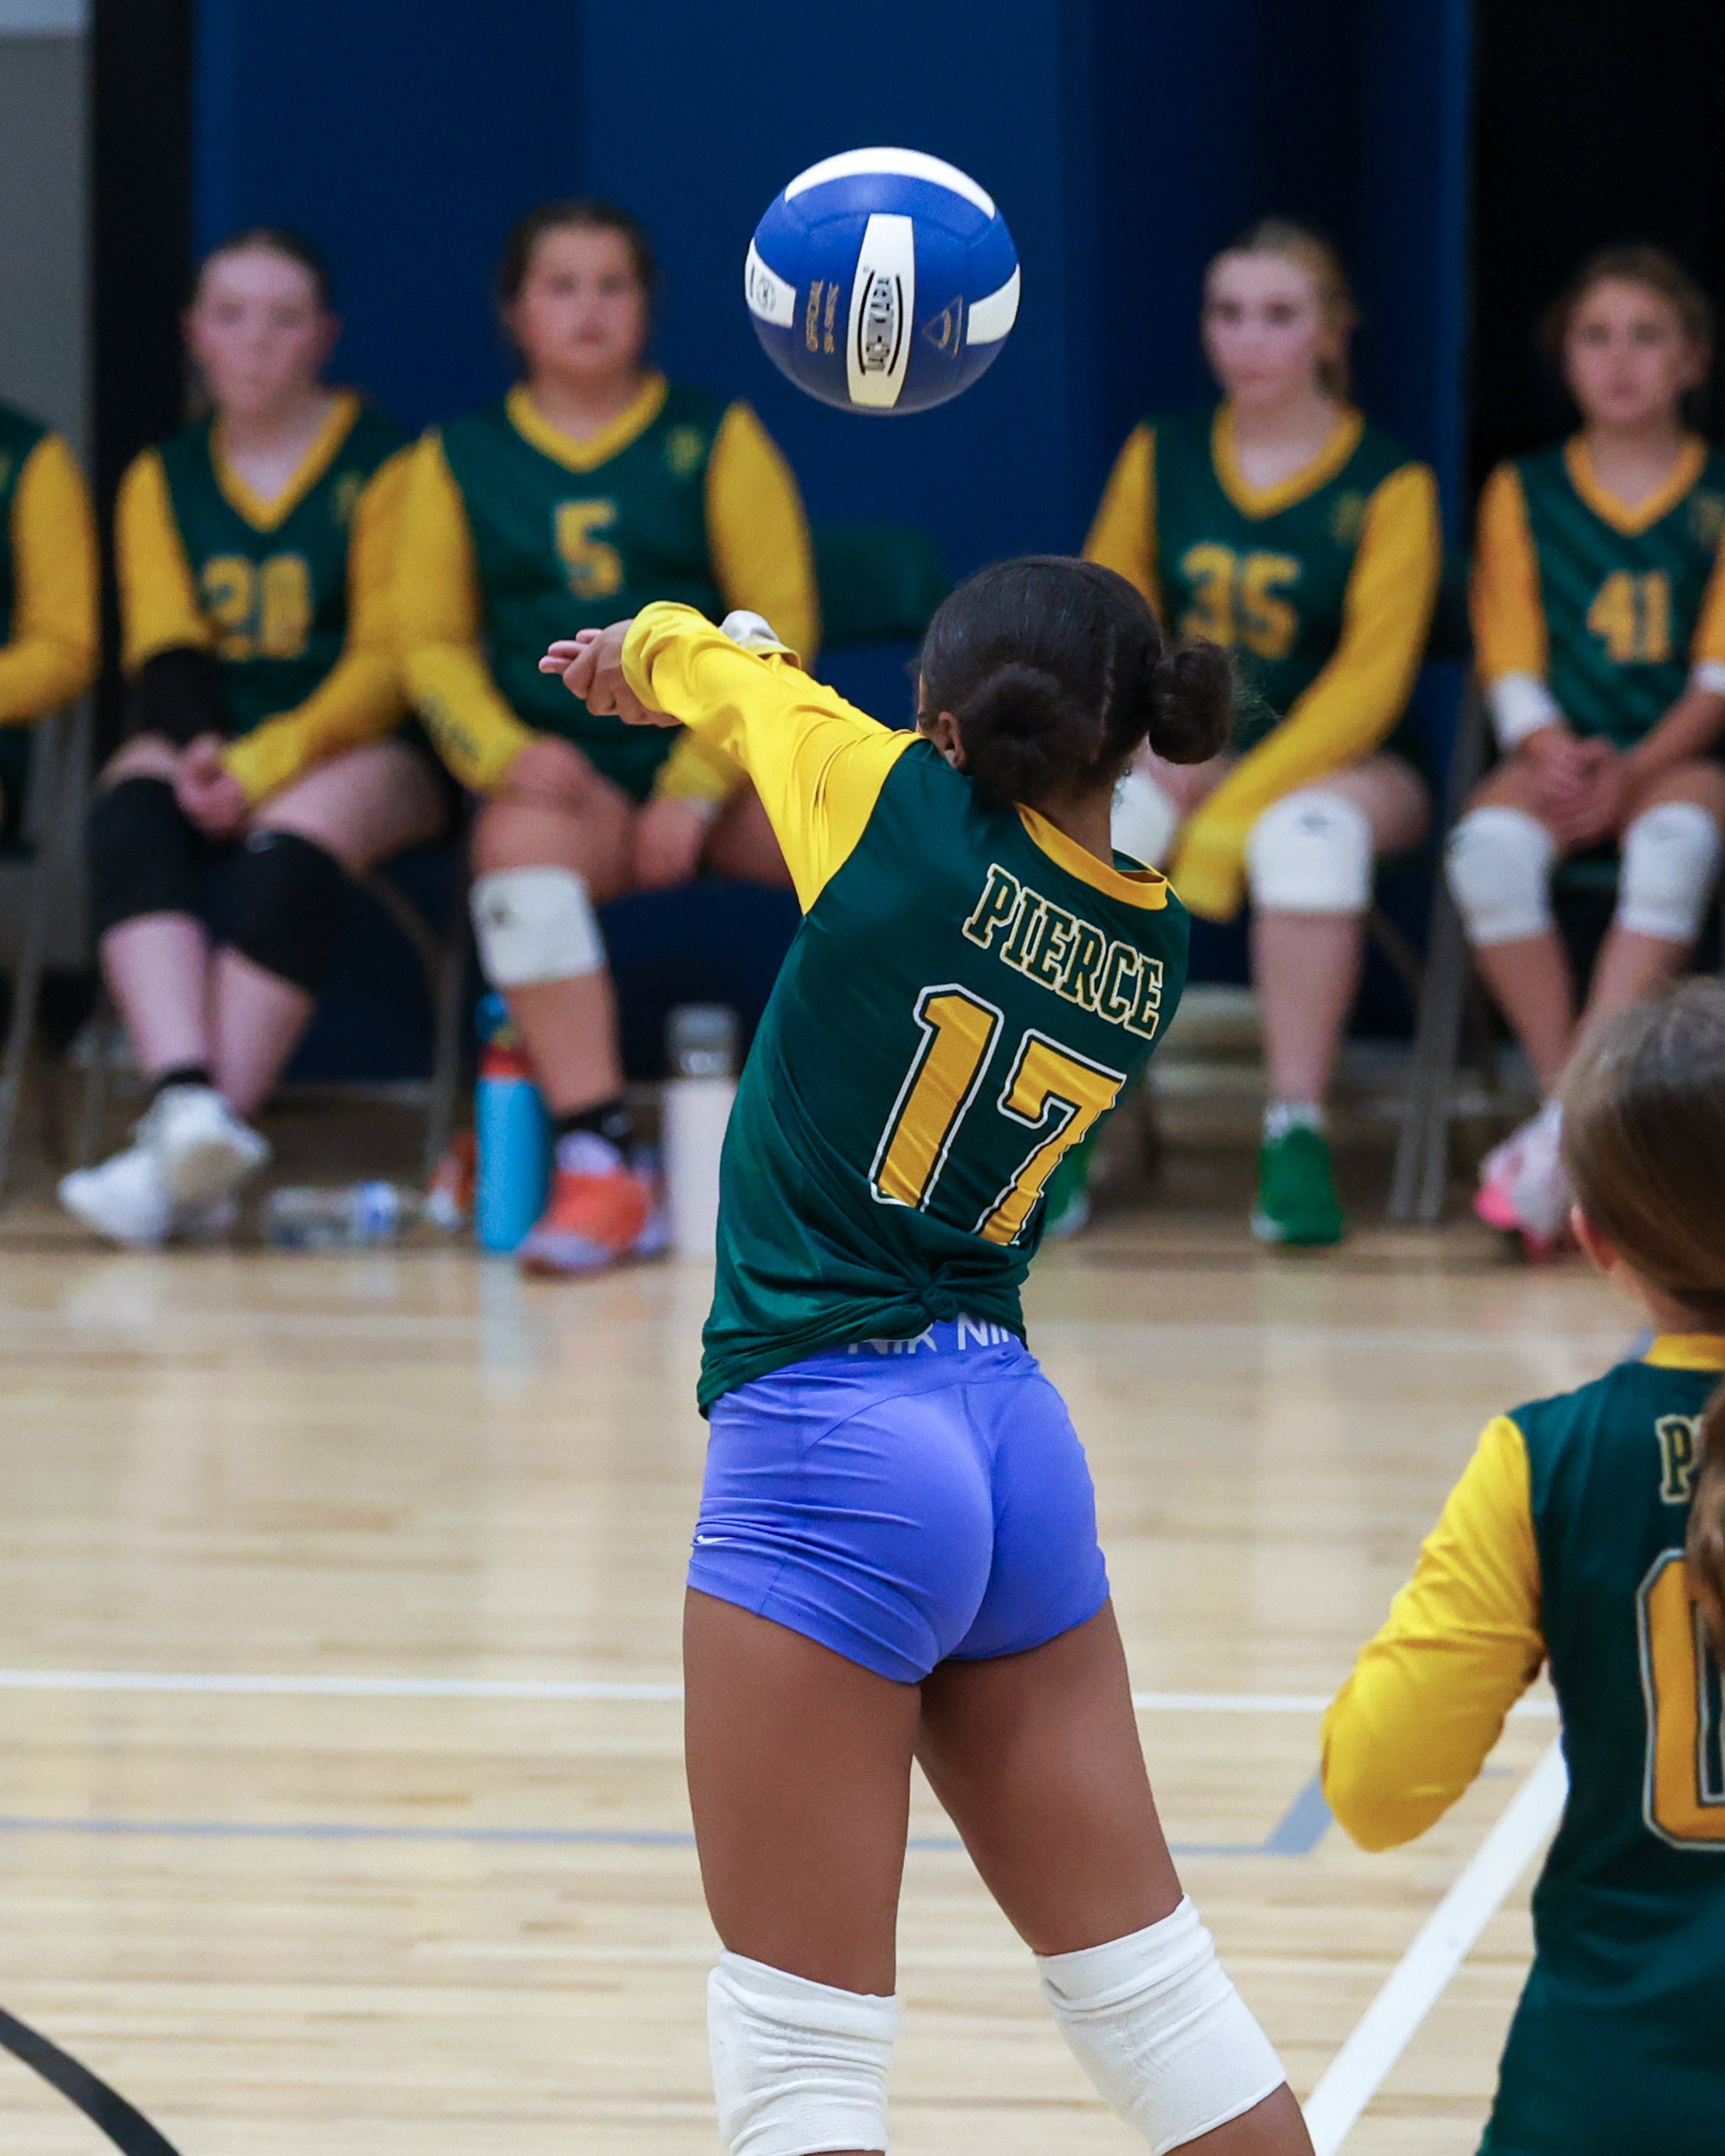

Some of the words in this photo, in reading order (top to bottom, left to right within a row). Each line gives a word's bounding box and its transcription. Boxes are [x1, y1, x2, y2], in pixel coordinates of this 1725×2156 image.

[553, 498, 622, 600] 5
[1181, 540, 1302, 660] 35
[1587, 569, 1671, 664] 41
[963, 863, 1164, 1040] PIERCE
[869, 983, 1127, 1246] 17
[1654, 1414, 1704, 1504] P
